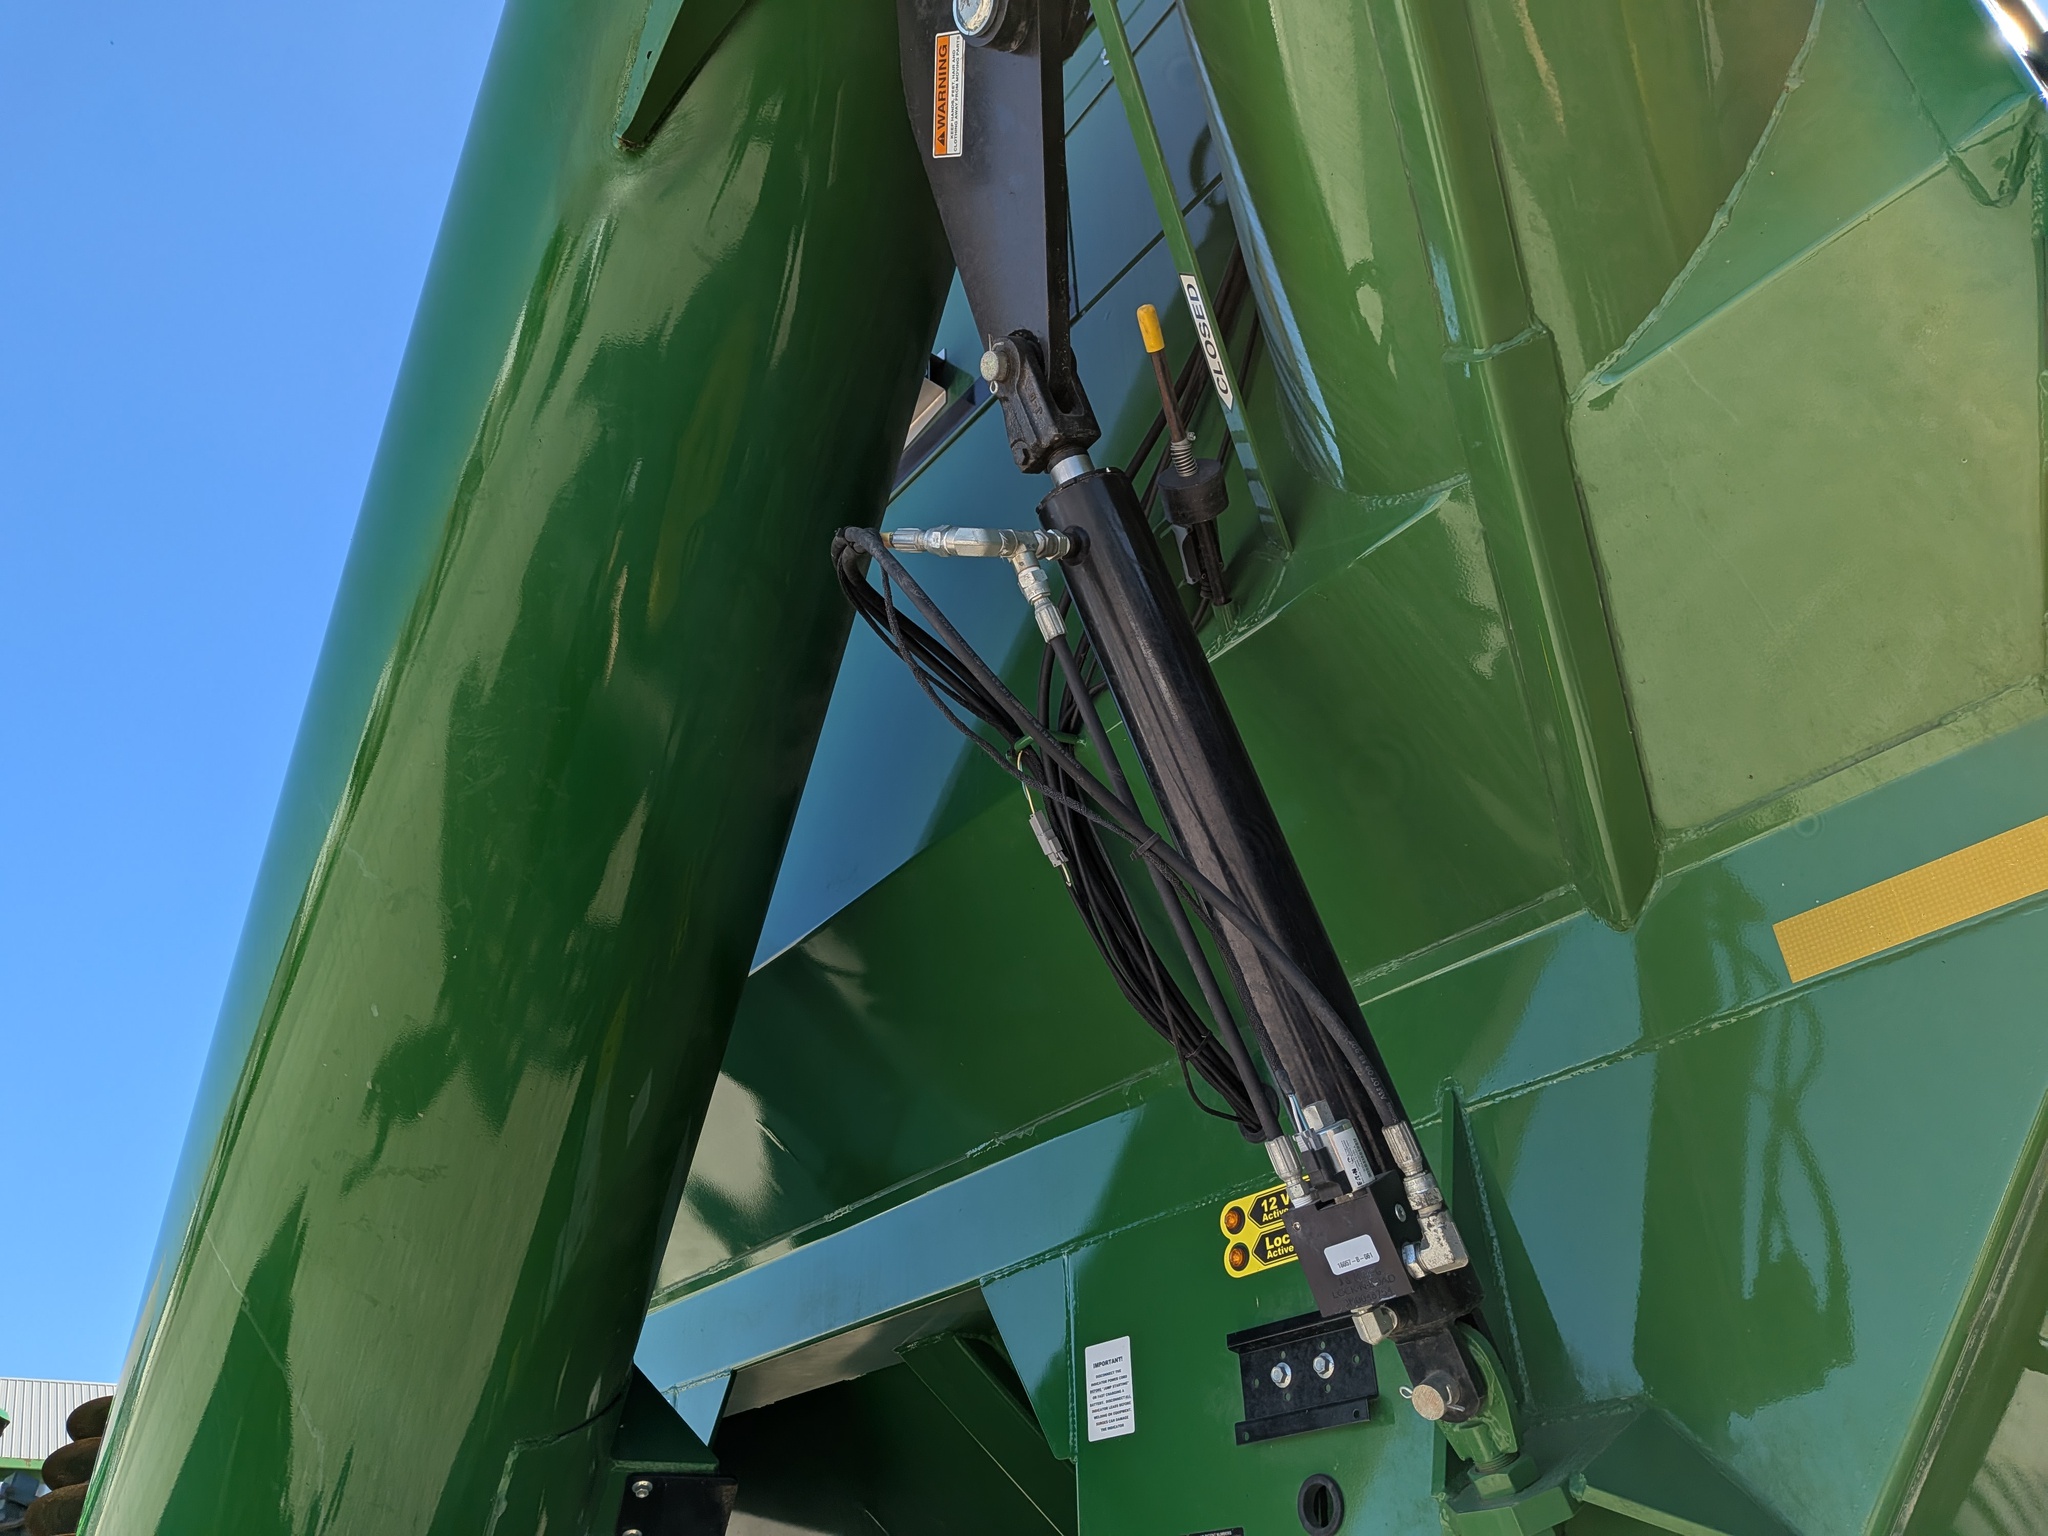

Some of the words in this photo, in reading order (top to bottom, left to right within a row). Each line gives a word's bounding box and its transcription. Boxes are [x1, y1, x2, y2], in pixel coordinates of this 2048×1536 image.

[937, 44, 948, 130] WARNING
[1187, 283, 1229, 394] CLOSED
[1261, 1196, 1278, 1213] 12
[1266, 1245, 1295, 1259] Active
[1092, 1356, 1123, 1369] IMPORTANT!
